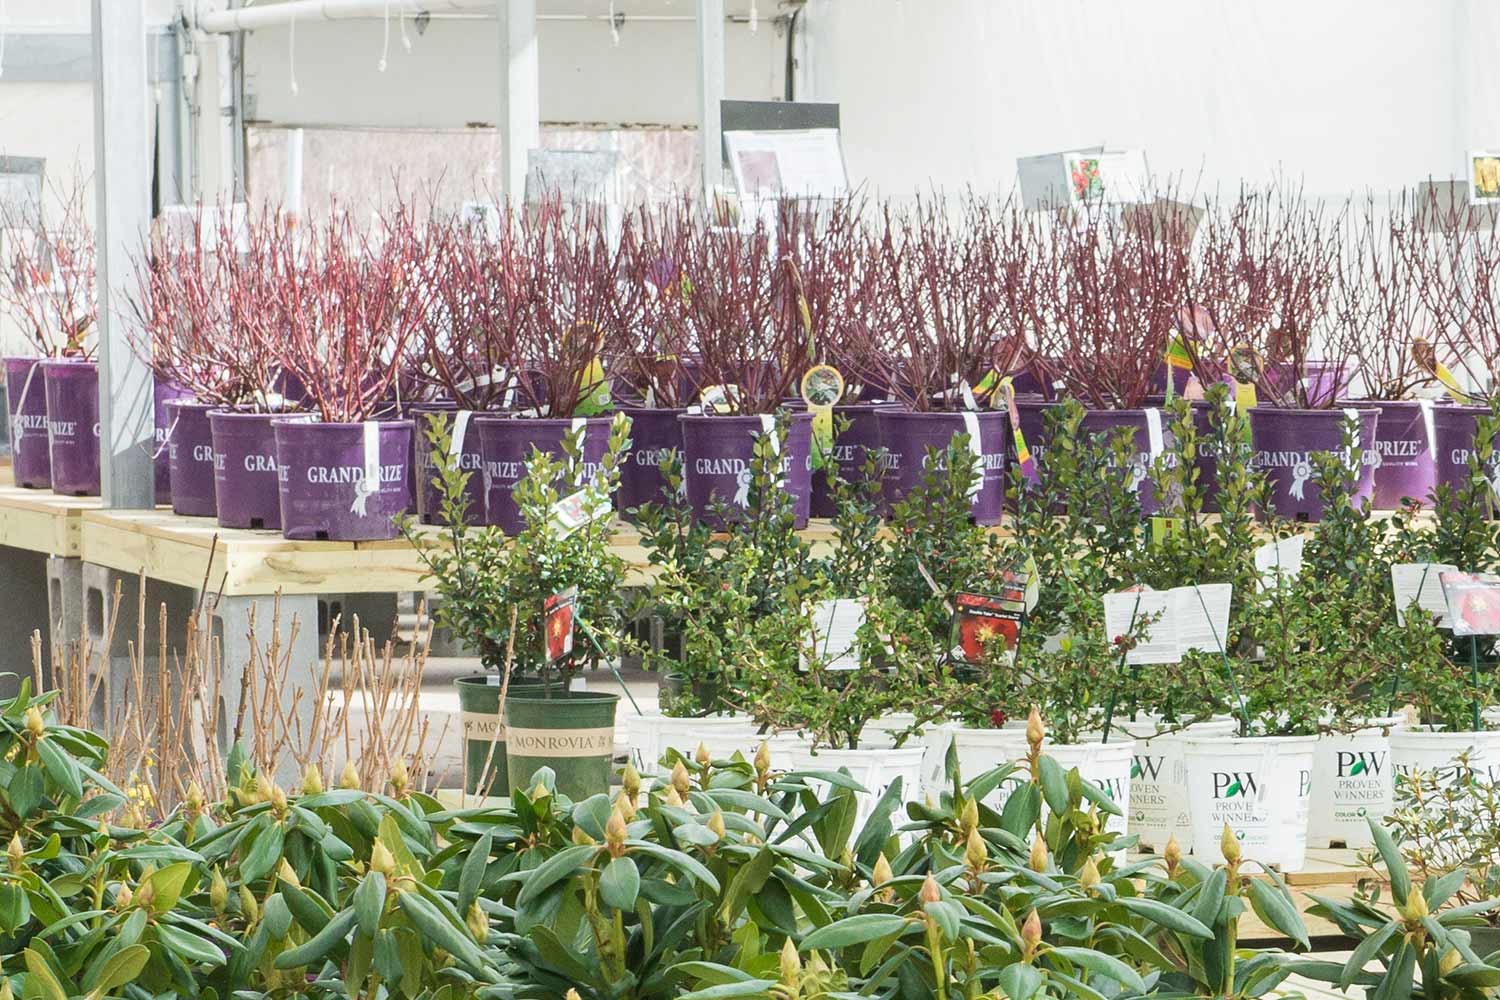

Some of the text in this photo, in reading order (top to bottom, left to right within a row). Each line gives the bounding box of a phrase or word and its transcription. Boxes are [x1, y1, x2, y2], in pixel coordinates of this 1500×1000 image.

[1375, 440, 1417, 456] PRIZE
[244, 455, 277, 471] GRA
[696, 457, 745, 474] GRAND
[1258, 450, 1300, 467] GRAND
[307, 466, 363, 483] GRAND
[379, 464, 402, 482] RIZE
[516, 736, 592, 750] MONROVIA
[1129, 755, 1165, 782] W
[1336, 751, 1388, 777] PW
[1130, 784, 1160, 793] OVEN
[1297, 770, 1312, 798] P
[1338, 780, 1382, 790] PROVEN
[1333, 790, 1386, 801] WINNERS
[1215, 801, 1254, 811] PROVE
